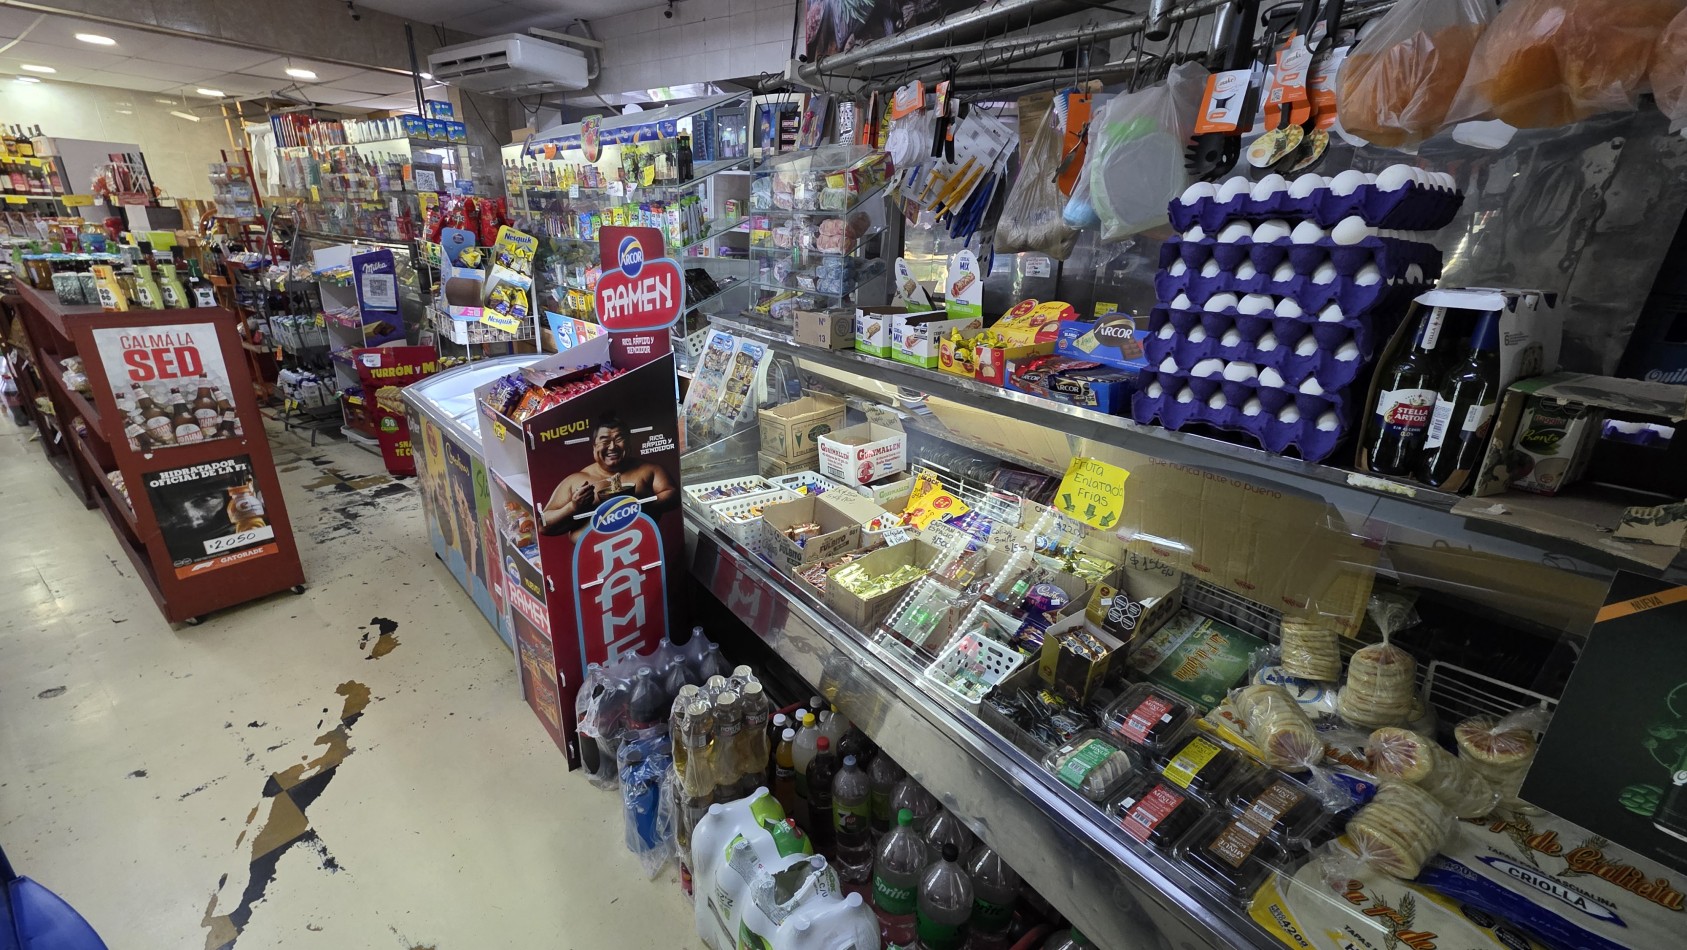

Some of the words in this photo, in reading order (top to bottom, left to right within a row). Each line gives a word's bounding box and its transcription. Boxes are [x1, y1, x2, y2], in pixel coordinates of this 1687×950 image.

[504, 232, 532, 243] Nesquik
[362, 261, 387, 274] Milka
[620, 253, 643, 266] ARCOR
[960, 262, 969, 271] MIX
[601, 272, 673, 321] RAMEN
[488, 315, 512, 325] Nesquik
[819, 335, 826, 343] 13
[893, 333, 902, 343] MIX
[1095, 322, 1132, 339] ARCOR
[1427, 327, 1436, 345] STELLA
[120, 332, 174, 349] CALMÁ
[177, 332, 194, 345] LA
[1504, 335, 1510, 346] 6
[123, 346, 204, 381] SED
[371, 363, 413, 378] TURRÓN
[1644, 367, 1687, 384] Quil
[1057, 383, 1080, 393] ARCOR
[1394, 413, 1427, 422] ARTOIS
[1397, 407, 1429, 416] STELLA
[540, 420, 590, 442] NUEVO!
[1520, 428, 1560, 443] Pronto
[640, 444, 675, 455] RENDIDOR
[857, 443, 901, 461] GUAYMALLEN
[150, 472, 200, 488] OFICIAL
[200, 469, 217, 478] DE
[218, 466, 234, 474] LA
[159, 459, 236, 480] HIDRATADOR
[1148, 457, 1167, 468] que
[1169, 462, 1200, 477] nunca
[1244, 481, 1282, 499] bueno
[595, 502, 639, 528] ARCOR
[820, 535, 846, 553] FULBITO
[220, 547, 264, 563] GATORADE
[593, 528, 647, 669] RAME
[1630, 595, 1663, 612] NUEVA
[508, 581, 552, 637] RAMEN
[1525, 830, 1563, 857] de
[1563, 847, 1687, 912] Galicia
[874, 876, 911, 900] Sprite
[1507, 866, 1588, 910] CRIOLLA
[1548, 872, 1618, 910] PASCUALINA
[1344, 925, 1373, 948] TAPAS
